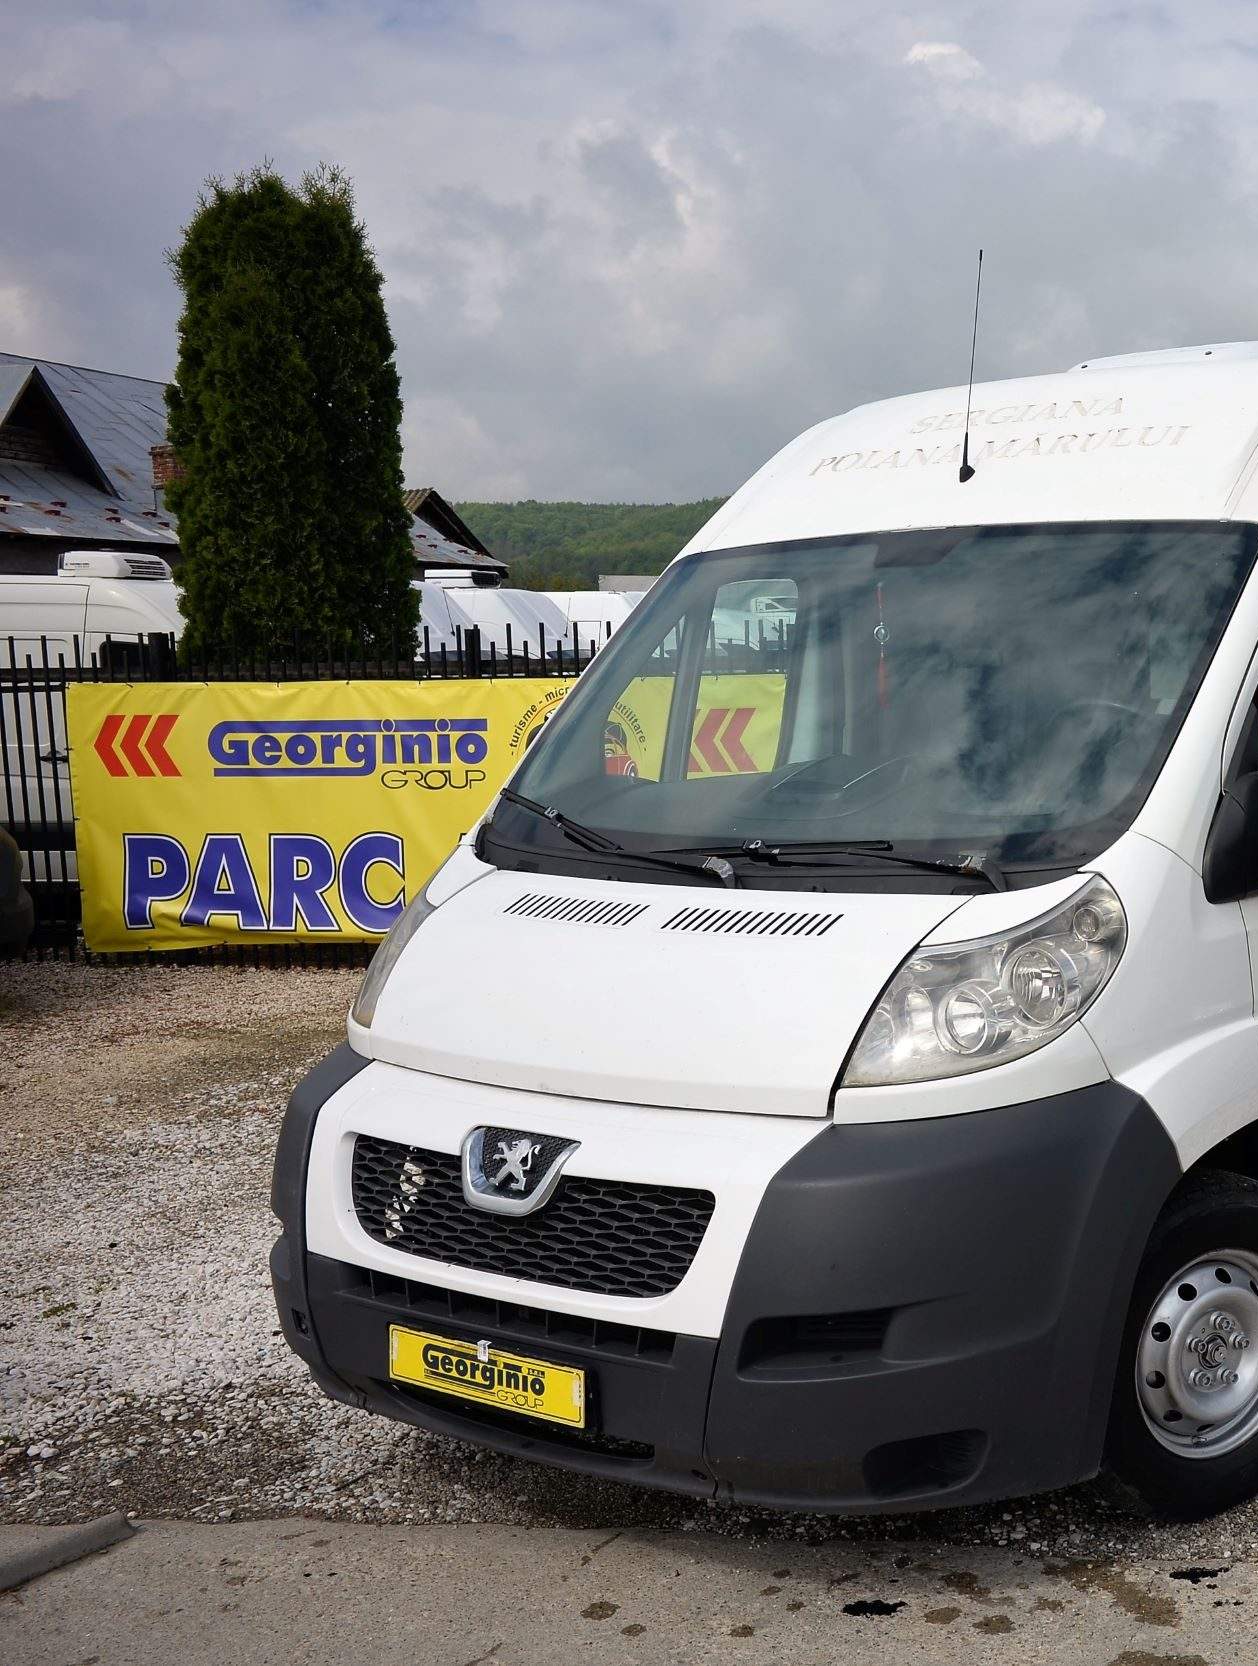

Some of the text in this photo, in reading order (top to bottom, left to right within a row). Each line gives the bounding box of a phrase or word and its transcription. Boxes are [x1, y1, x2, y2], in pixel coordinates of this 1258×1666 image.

[508, 686, 571, 748] turisme micr
[208, 718, 488, 777] Georginio
[381, 769, 486, 790] GROUP
[123, 832, 406, 934] PARC
[422, 1343, 546, 1397] Georginio
[496, 1389, 544, 1409] GROUP
